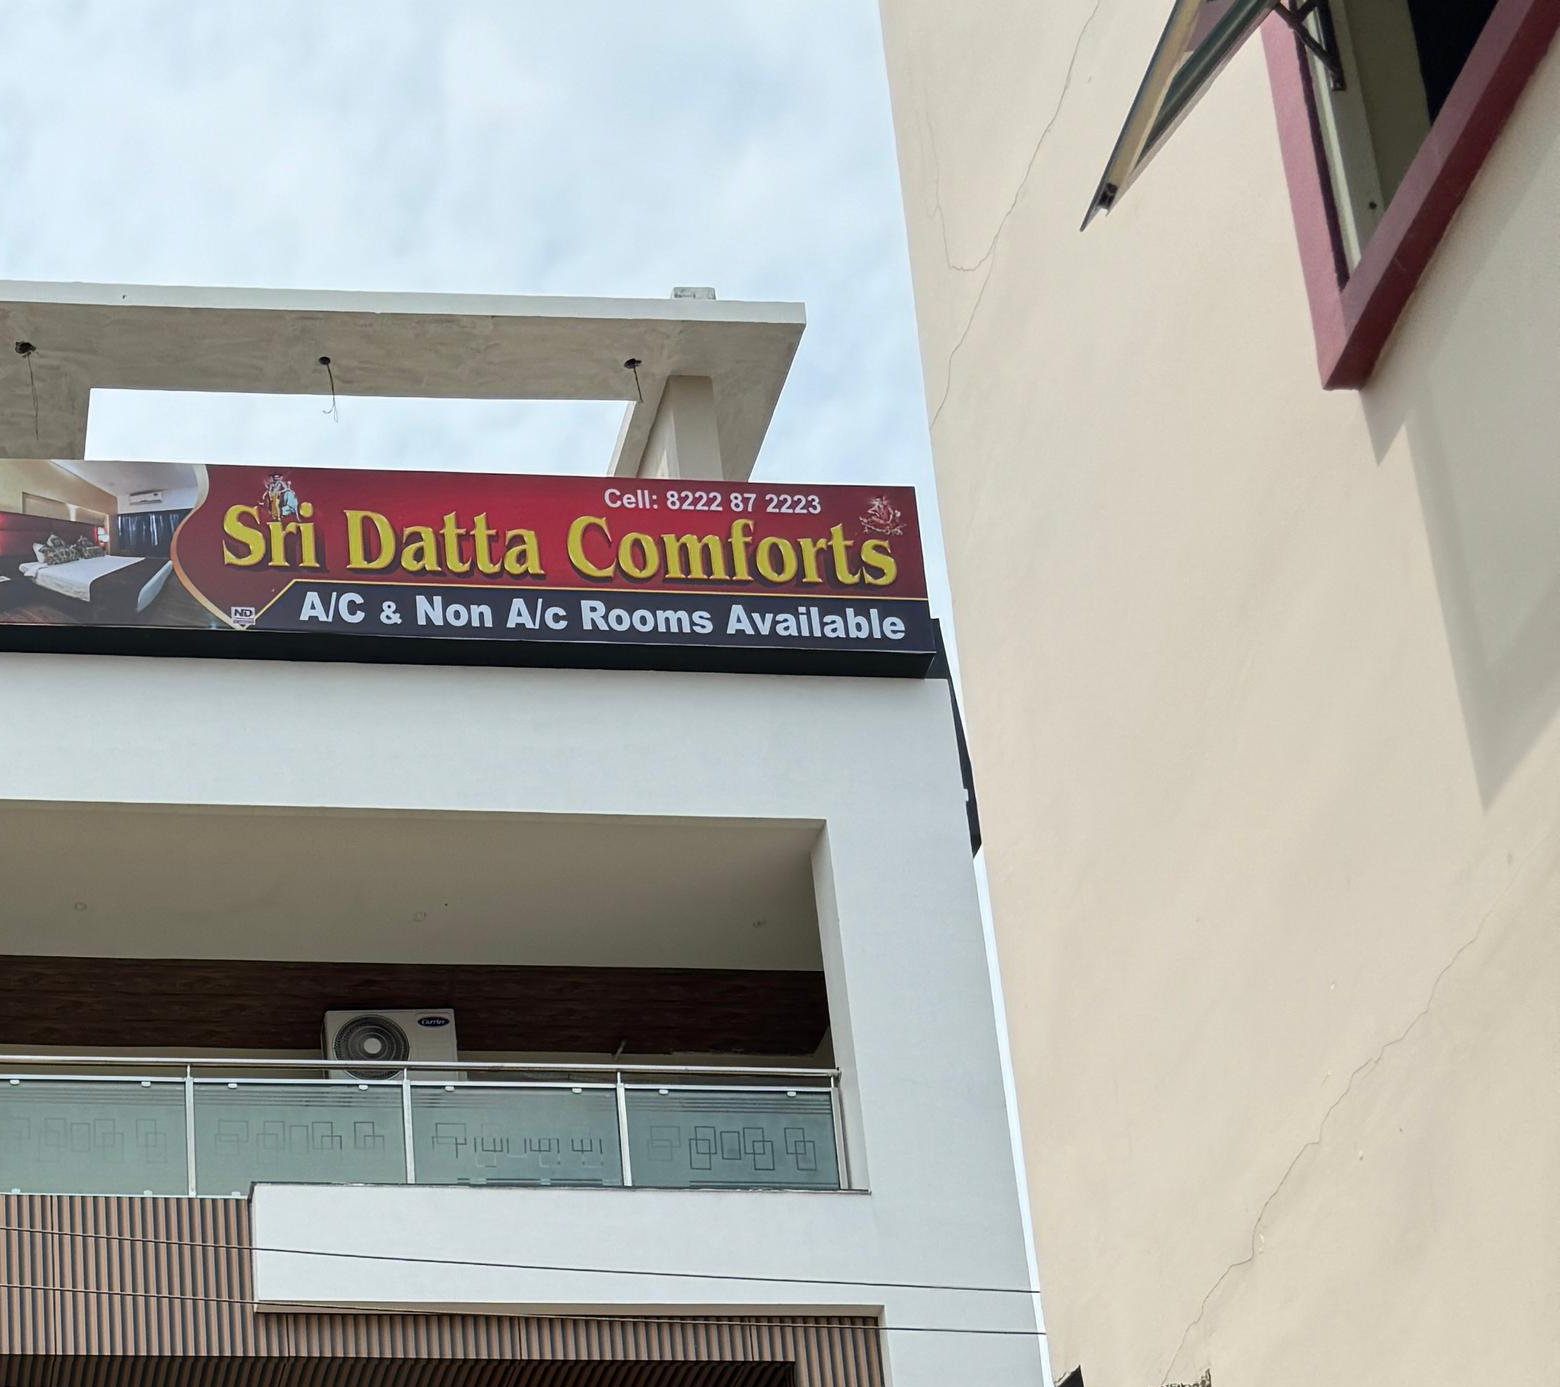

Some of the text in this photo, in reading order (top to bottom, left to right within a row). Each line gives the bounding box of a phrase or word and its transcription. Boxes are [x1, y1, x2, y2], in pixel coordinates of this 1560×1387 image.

[603, 488, 822, 514] Cell: 8222 87 2223
[222, 502, 898, 586] Sri Datta Comforts
[298, 591, 906, 640] A/C & Non A/c Rooms Available
